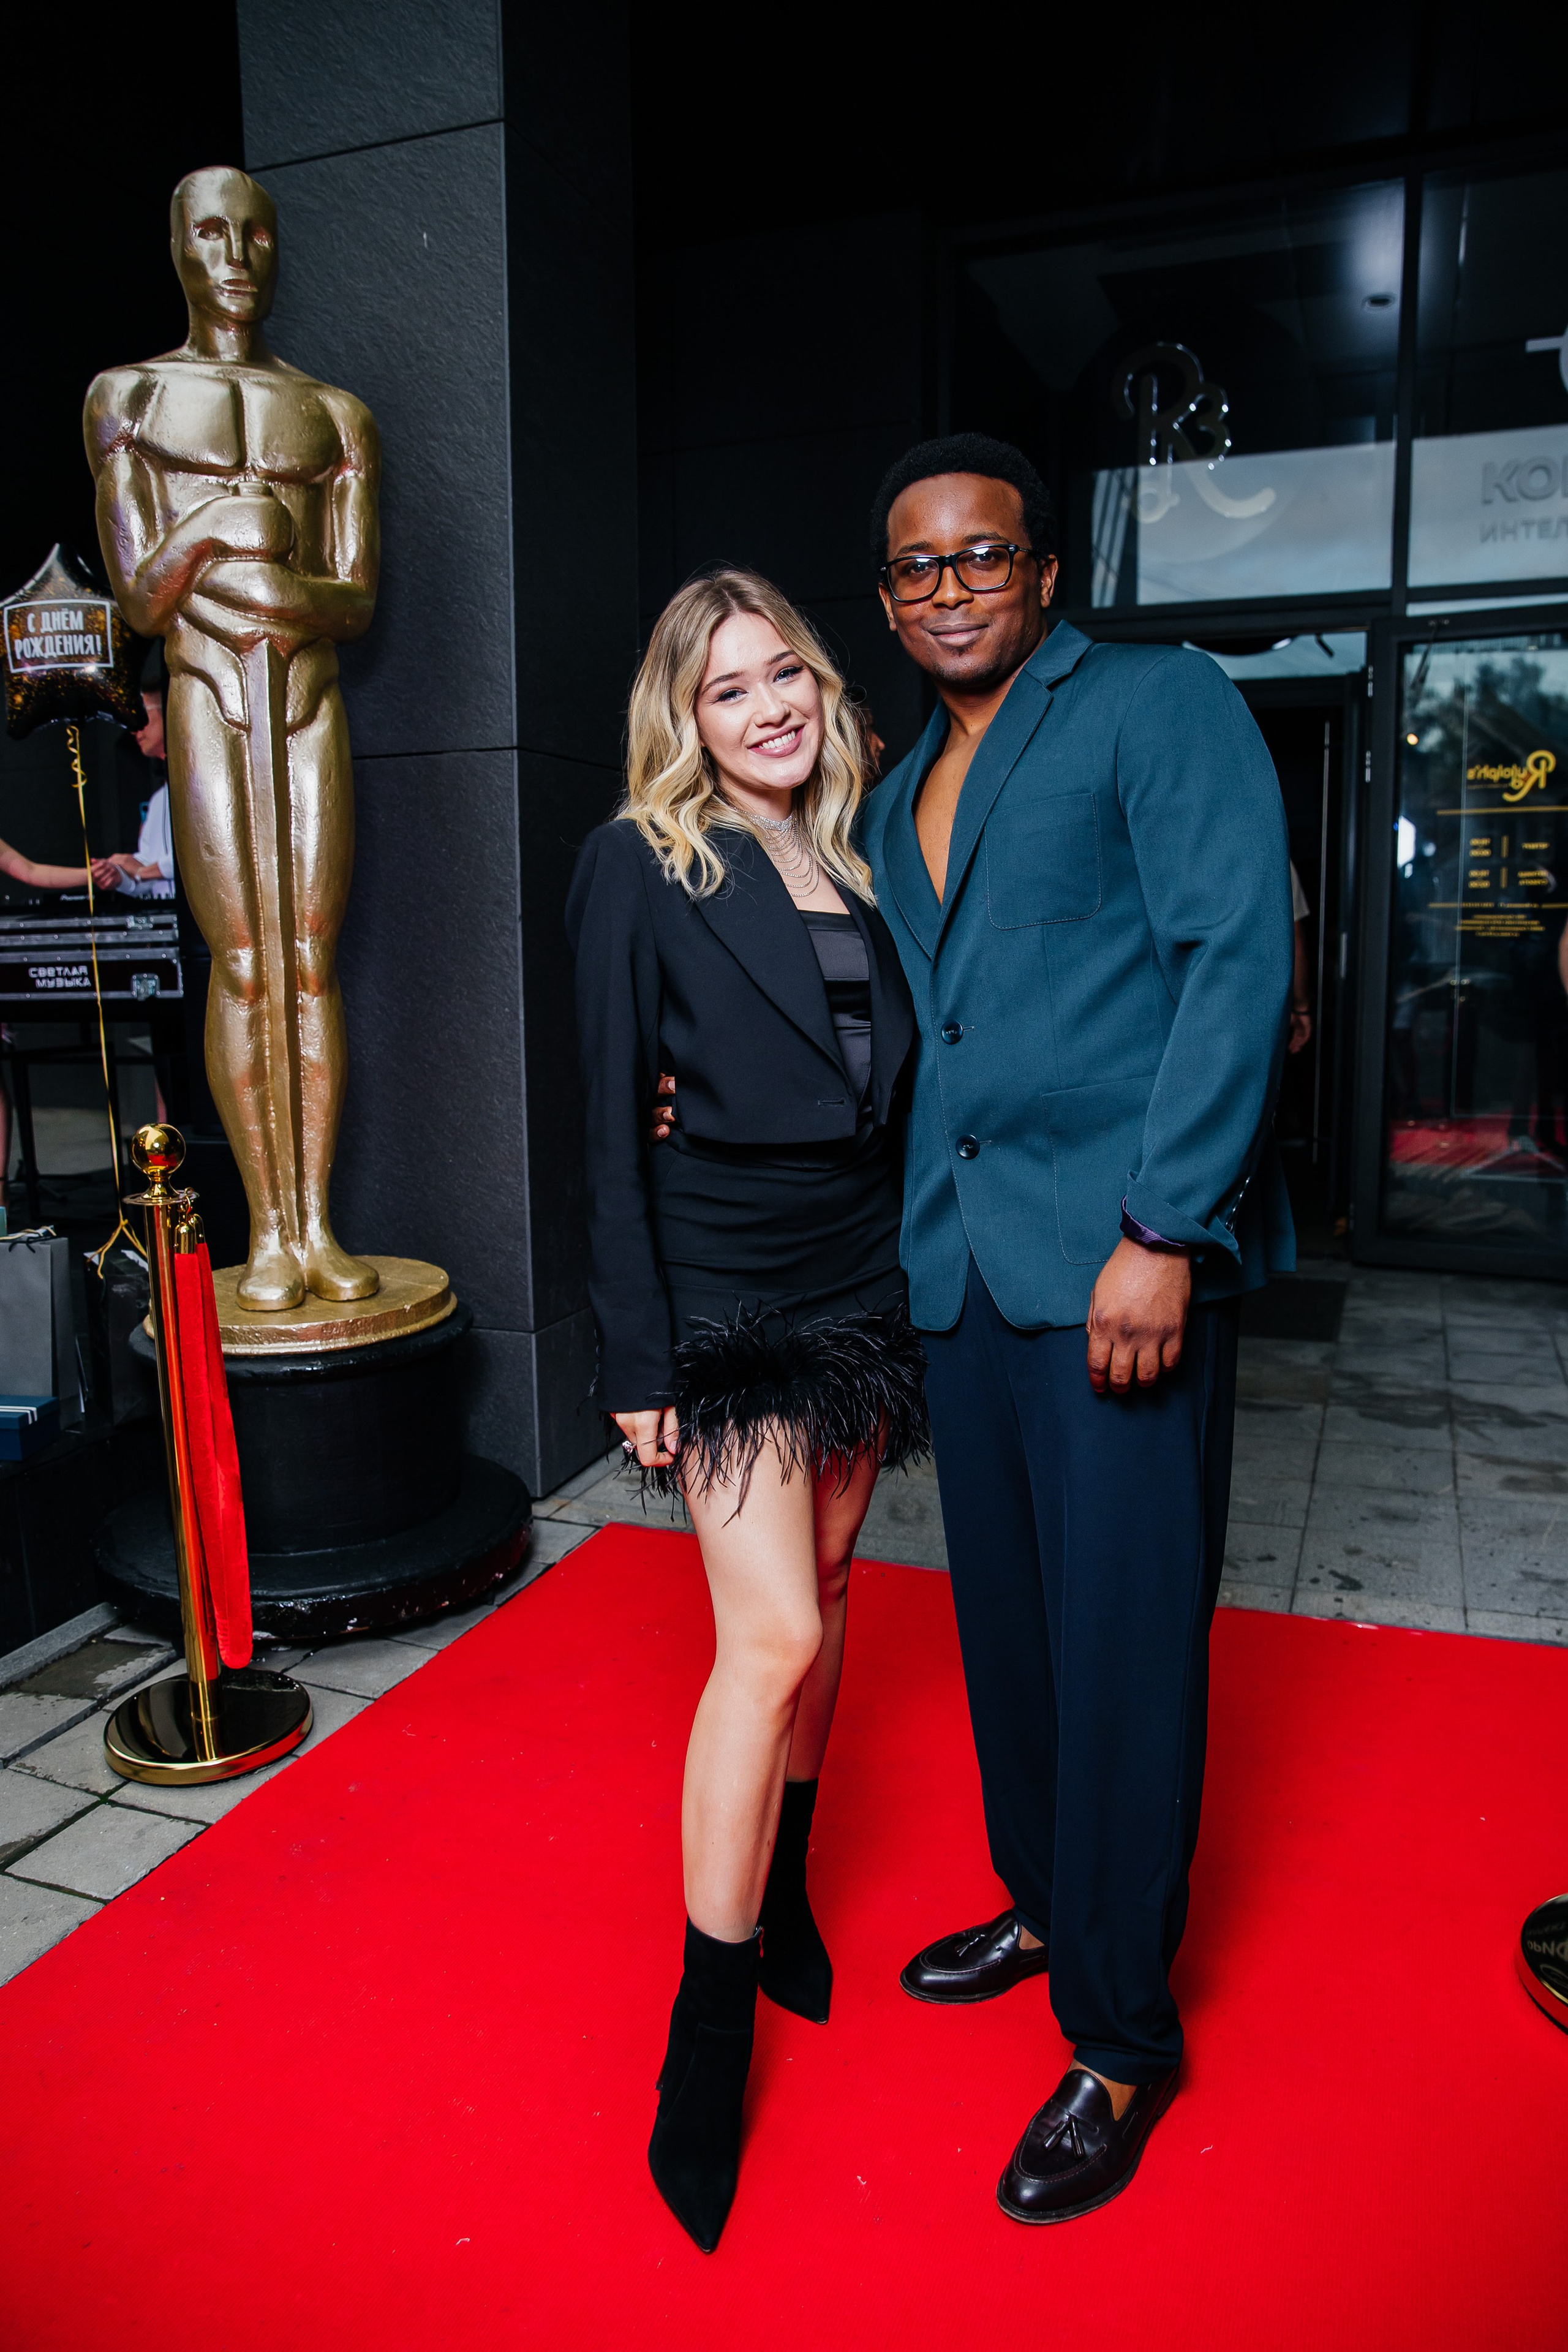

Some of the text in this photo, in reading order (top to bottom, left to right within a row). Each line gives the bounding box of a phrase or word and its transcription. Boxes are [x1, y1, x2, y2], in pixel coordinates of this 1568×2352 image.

[27, 608, 84, 633] С ДНЁМ
[14, 634, 102, 660] РОЖДЕНИЯ!
[36, 976, 91, 989] МУЗЫКА
